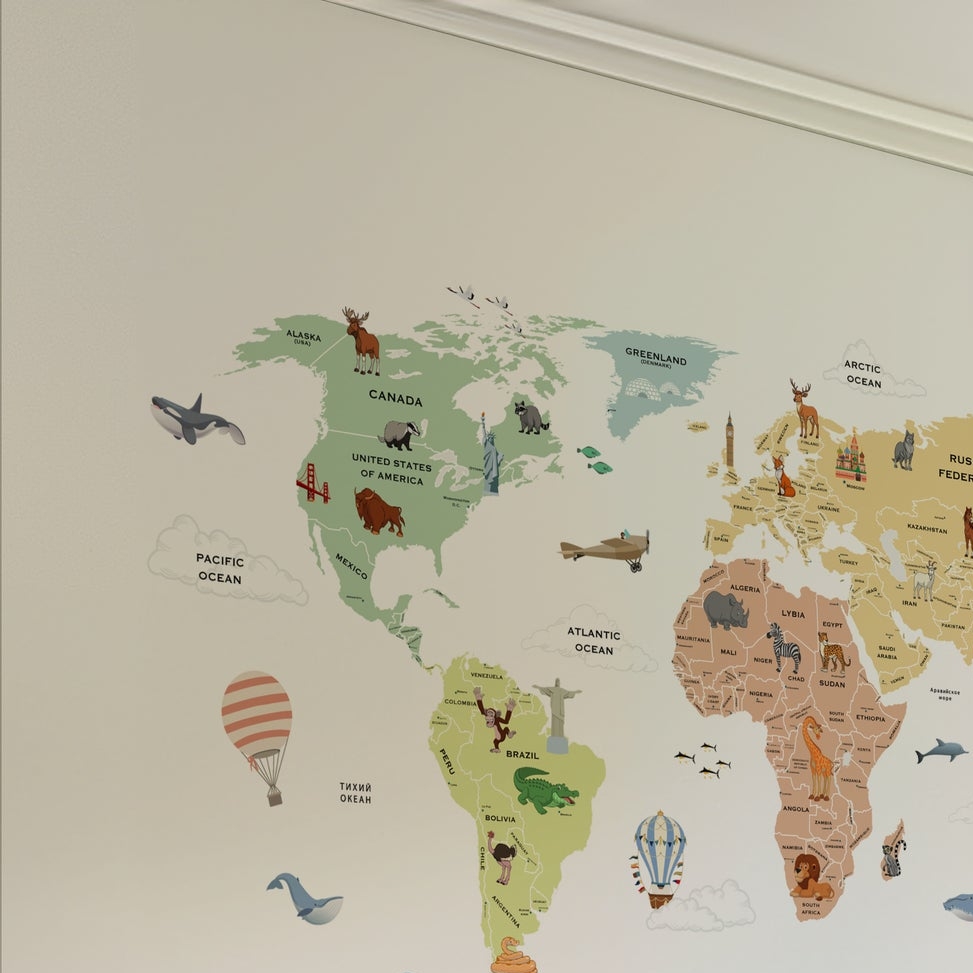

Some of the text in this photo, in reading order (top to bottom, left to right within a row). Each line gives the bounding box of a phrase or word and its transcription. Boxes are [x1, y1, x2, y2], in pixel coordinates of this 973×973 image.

[286, 330, 322, 342] ALASKA
[625, 347, 687, 366] GREENLAND
[640, 359, 672, 369] (DENMARK)
[844, 360, 881, 374] ARCTIC
[847, 375, 882, 389] OCEAN
[369, 390, 423, 407] CANADA
[352, 453, 432, 472] UNITED STATES
[360, 469, 424, 486] OF AMERICA
[907, 524, 948, 534] KAZAKHSTAN
[196, 553, 244, 568] PACIFIC
[335, 553, 368, 580] MEXICO
[198, 571, 242, 585] OCEAN
[730, 584, 760, 593] ALGERIA
[781, 610, 806, 619] LYBIA
[567, 627, 621, 640] ATLANTIC
[677, 635, 710, 643] MAURITANIA
[575, 643, 614, 655] OCEAN
[470, 672, 503, 680] VENEZUELA
[819, 680, 846, 688] SUDAN
[856, 714, 886, 722] ETHIOPIA
[506, 750, 539, 760] BRAZIL
[440, 748, 455, 775] PERU
[340, 782, 372, 792] ТИХИЙ
[340, 794, 371, 804] ОКЕАН
[485, 815, 516, 823] BOLIVIA
[491, 895, 520, 928] ARGENTINA
